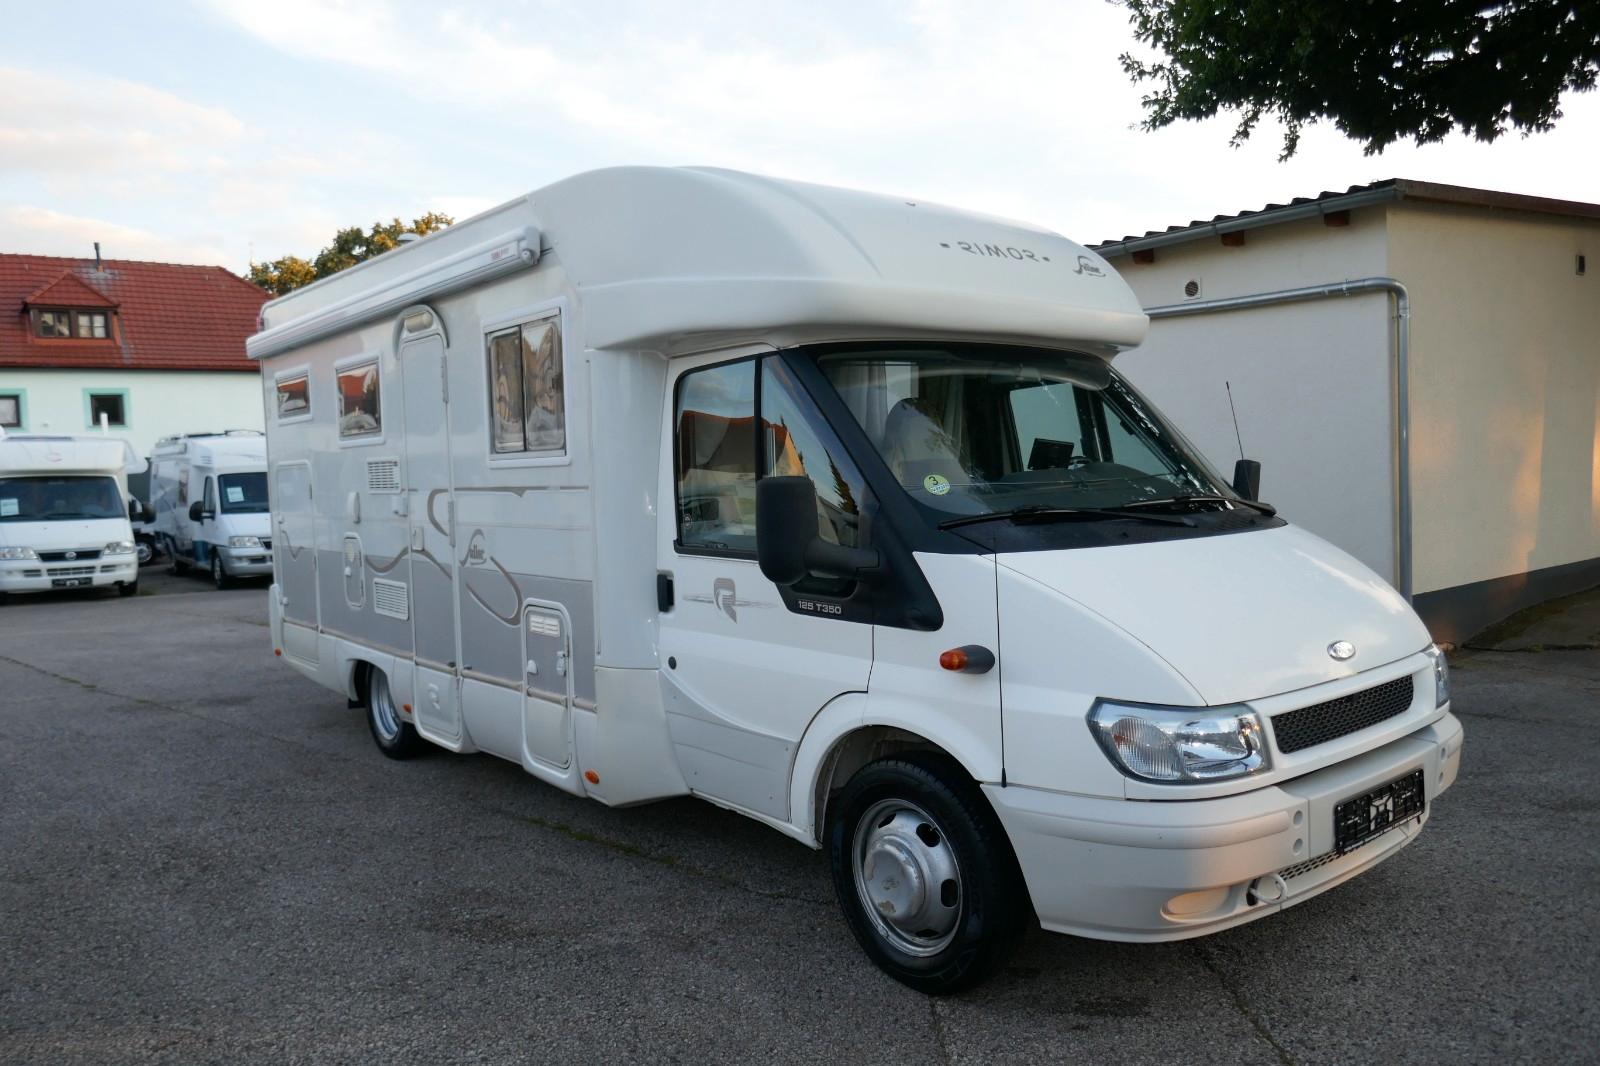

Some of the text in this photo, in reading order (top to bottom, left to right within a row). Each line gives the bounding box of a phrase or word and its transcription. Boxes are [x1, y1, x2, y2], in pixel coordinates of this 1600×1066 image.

[957, 241, 1040, 262] RIMOR
[928, 476, 938, 486] 3
[798, 600, 842, 615] 125 T350
